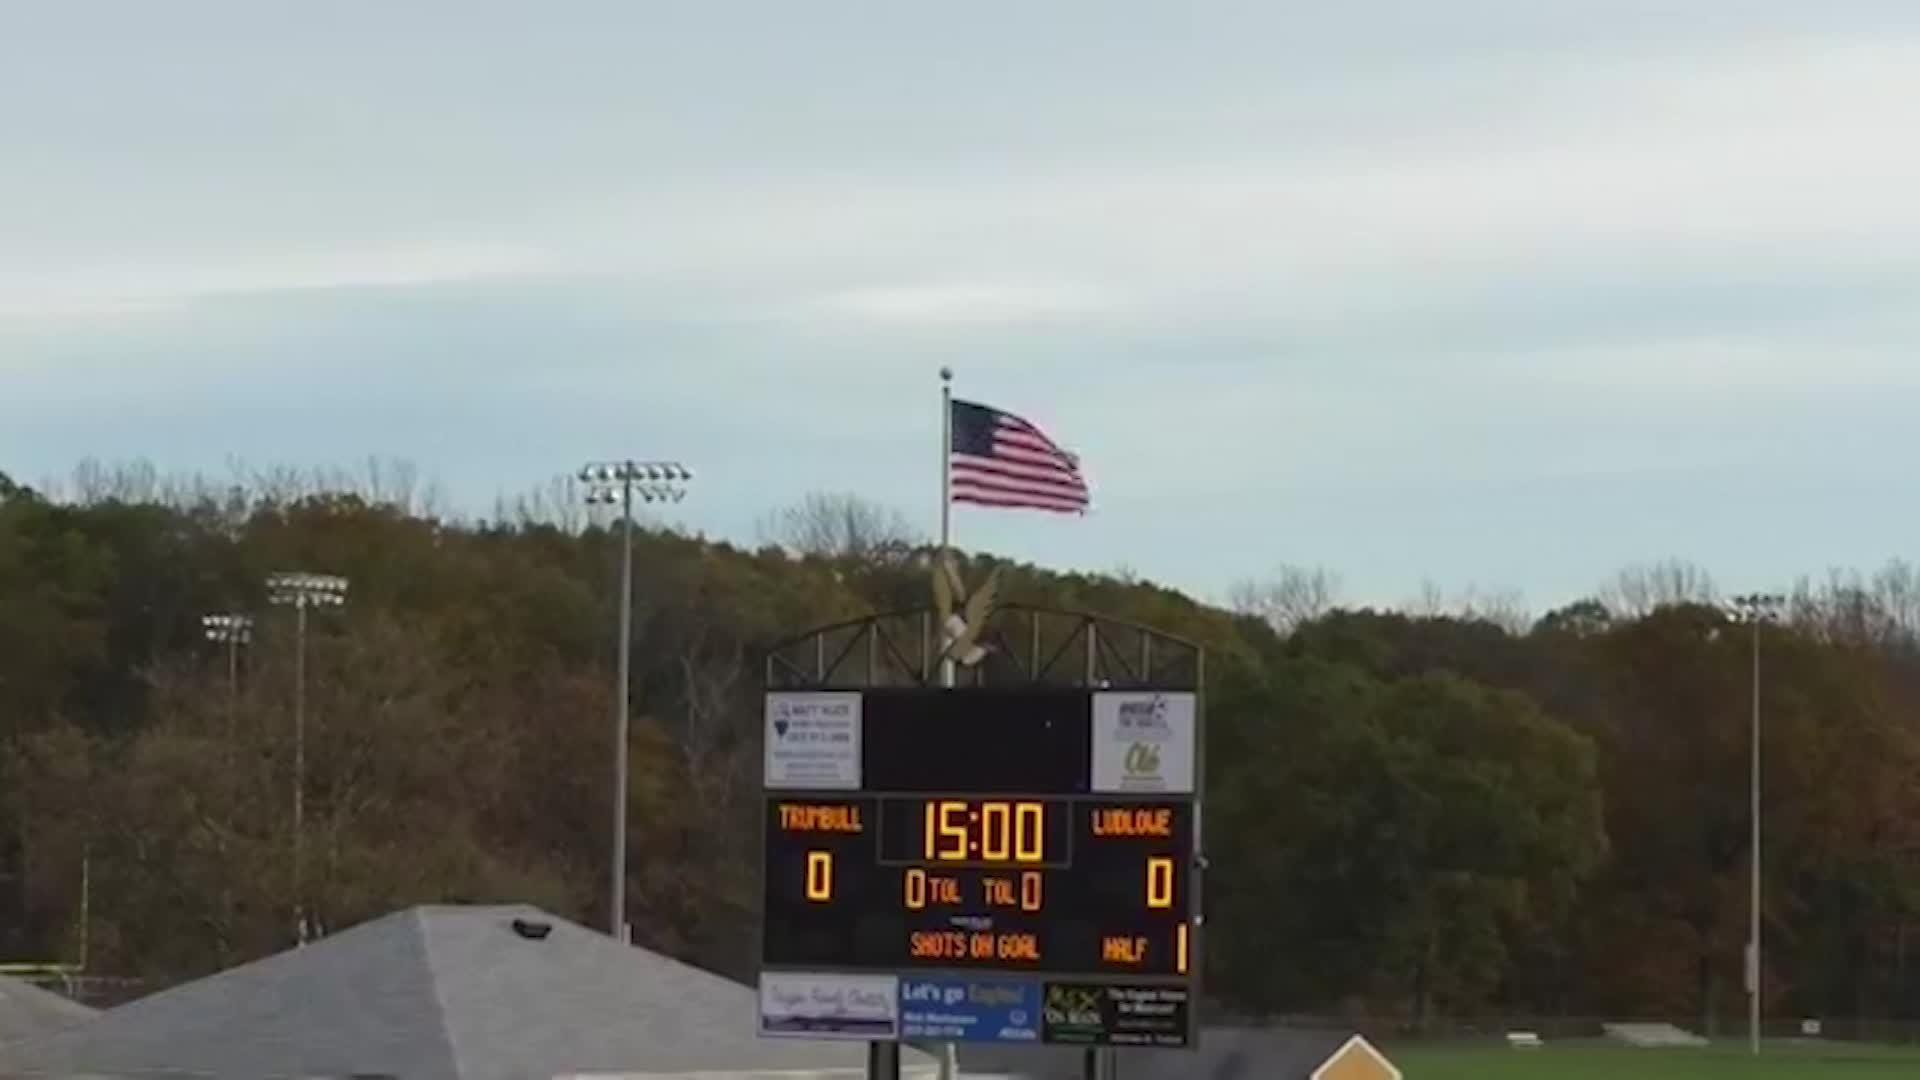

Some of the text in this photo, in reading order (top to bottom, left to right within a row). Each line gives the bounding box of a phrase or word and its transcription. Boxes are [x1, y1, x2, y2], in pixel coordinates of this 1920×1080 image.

[780, 804, 863, 832] TRUMBULL
[924, 801, 1043, 861] 15:00
[1092, 808, 1171, 836] LUDLOWE
[807, 851, 833, 900] 0
[905, 868, 962, 909] 0 TOL
[983, 872, 1042, 911] TOL 0
[1147, 858, 1172, 908] 0
[911, 931, 1040, 961] SHOTS ON GOAL
[1103, 923, 1187, 973] HALF 1
[902, 983, 941, 1000] Let's
[943, 988, 965, 1006] go
